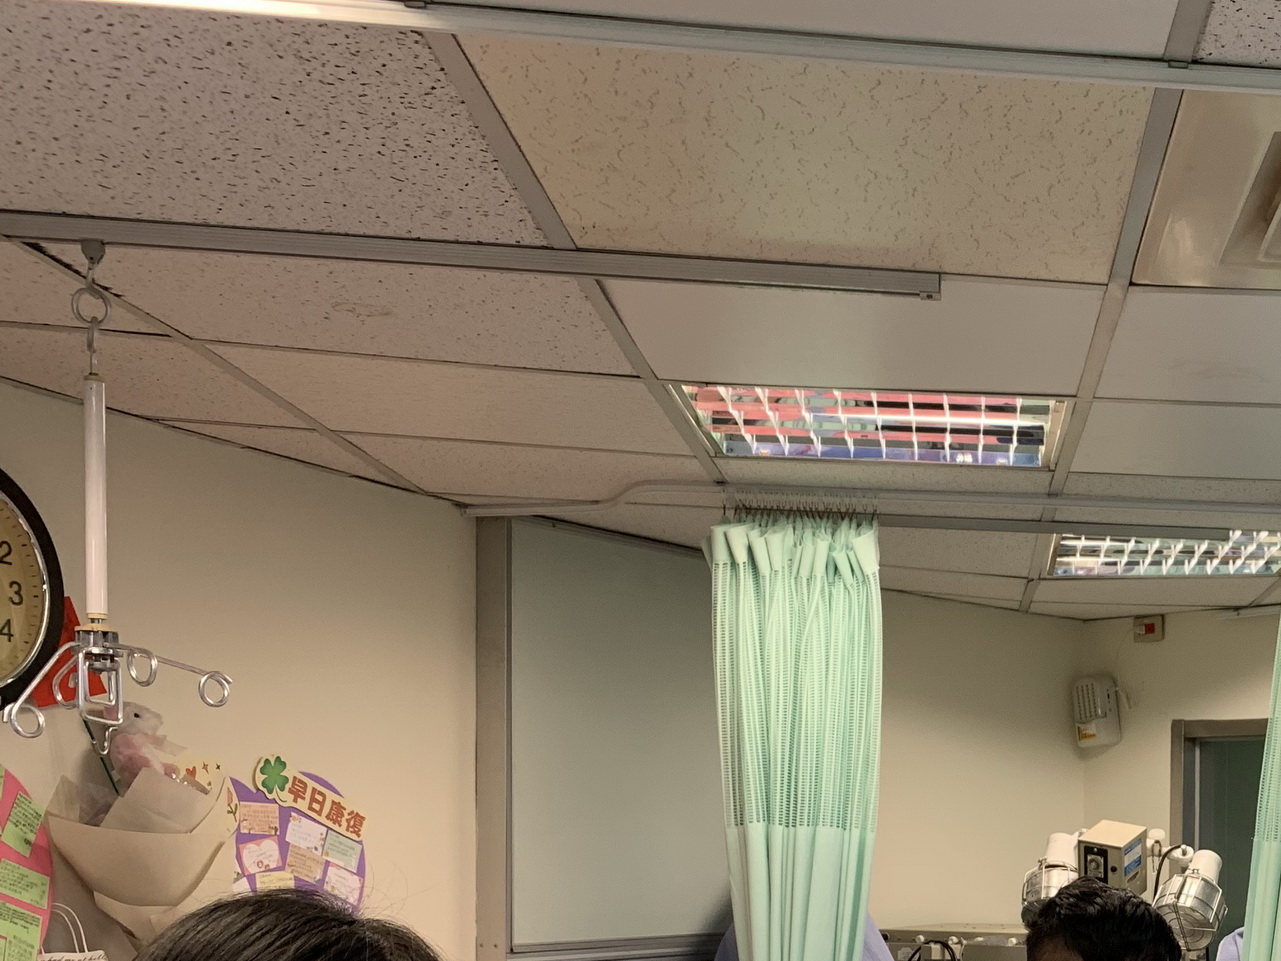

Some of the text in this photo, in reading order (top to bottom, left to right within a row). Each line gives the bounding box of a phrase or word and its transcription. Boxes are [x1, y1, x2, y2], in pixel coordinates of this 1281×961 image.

[9, 580, 24, 606] 3
[288, 775, 366, 839] 早日康復
